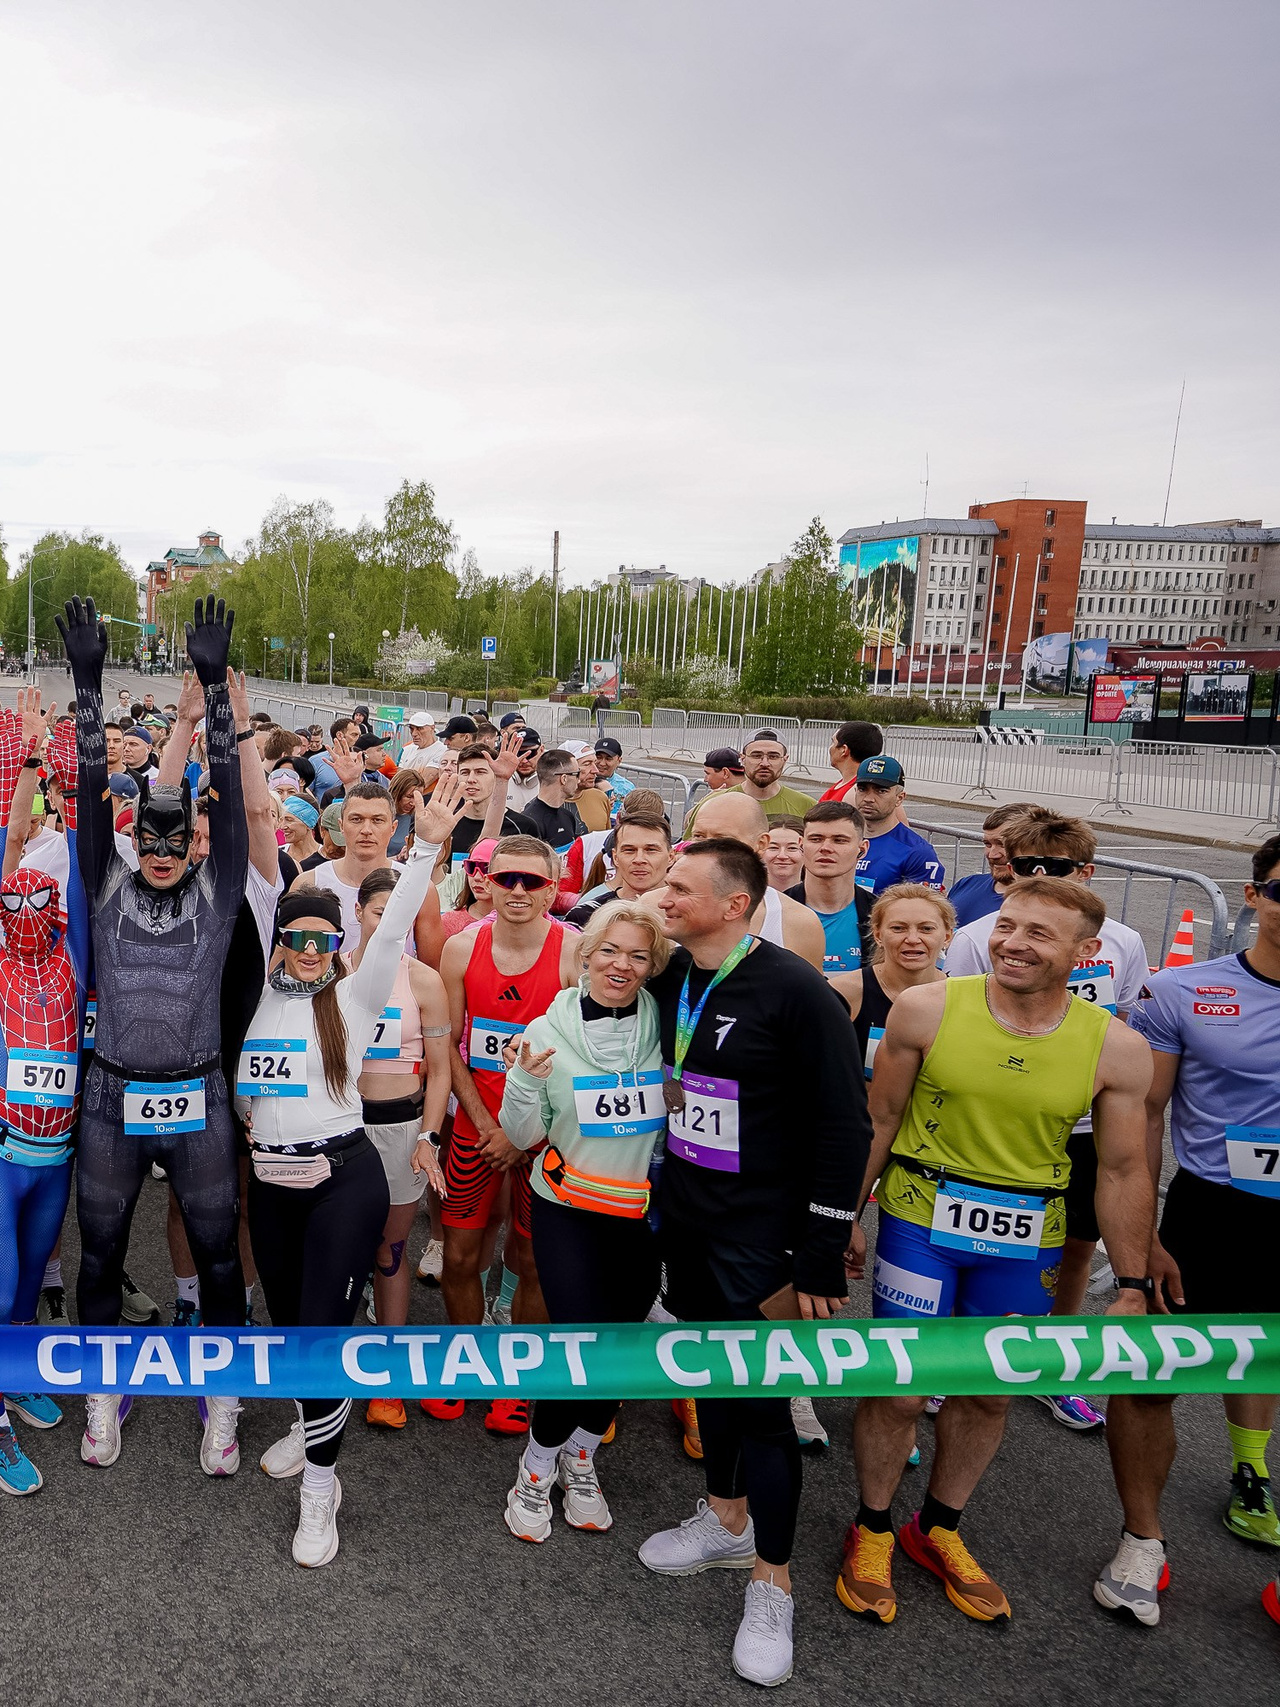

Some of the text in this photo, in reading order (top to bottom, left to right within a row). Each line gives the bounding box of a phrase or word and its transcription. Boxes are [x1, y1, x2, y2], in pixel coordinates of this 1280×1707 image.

[486, 638, 494, 651] P
[1137, 657, 1203, 671] Мемориальная
[925, 861, 939, 880] 7
[249, 1056, 291, 1079] 524
[23, 1065, 66, 1090] 570
[259, 1085, 269, 1095] 10
[34, 1094, 45, 1104] 10
[595, 1091, 647, 1118] 681
[140, 1096, 189, 1119] 639
[154, 1124, 165, 1133] 10
[612, 1124, 625, 1135] 10
[270, 1169, 309, 1177] DEMIX
[947, 1202, 1034, 1239] 1055
[971, 1240, 986, 1252] 10
[37, 1335, 285, 1386] СТАРТ
[341, 1332, 597, 1386] СТАРТ
[656, 1327, 919, 1387] СТАРТ
[983, 1324, 1267, 1383] СТАРТ
